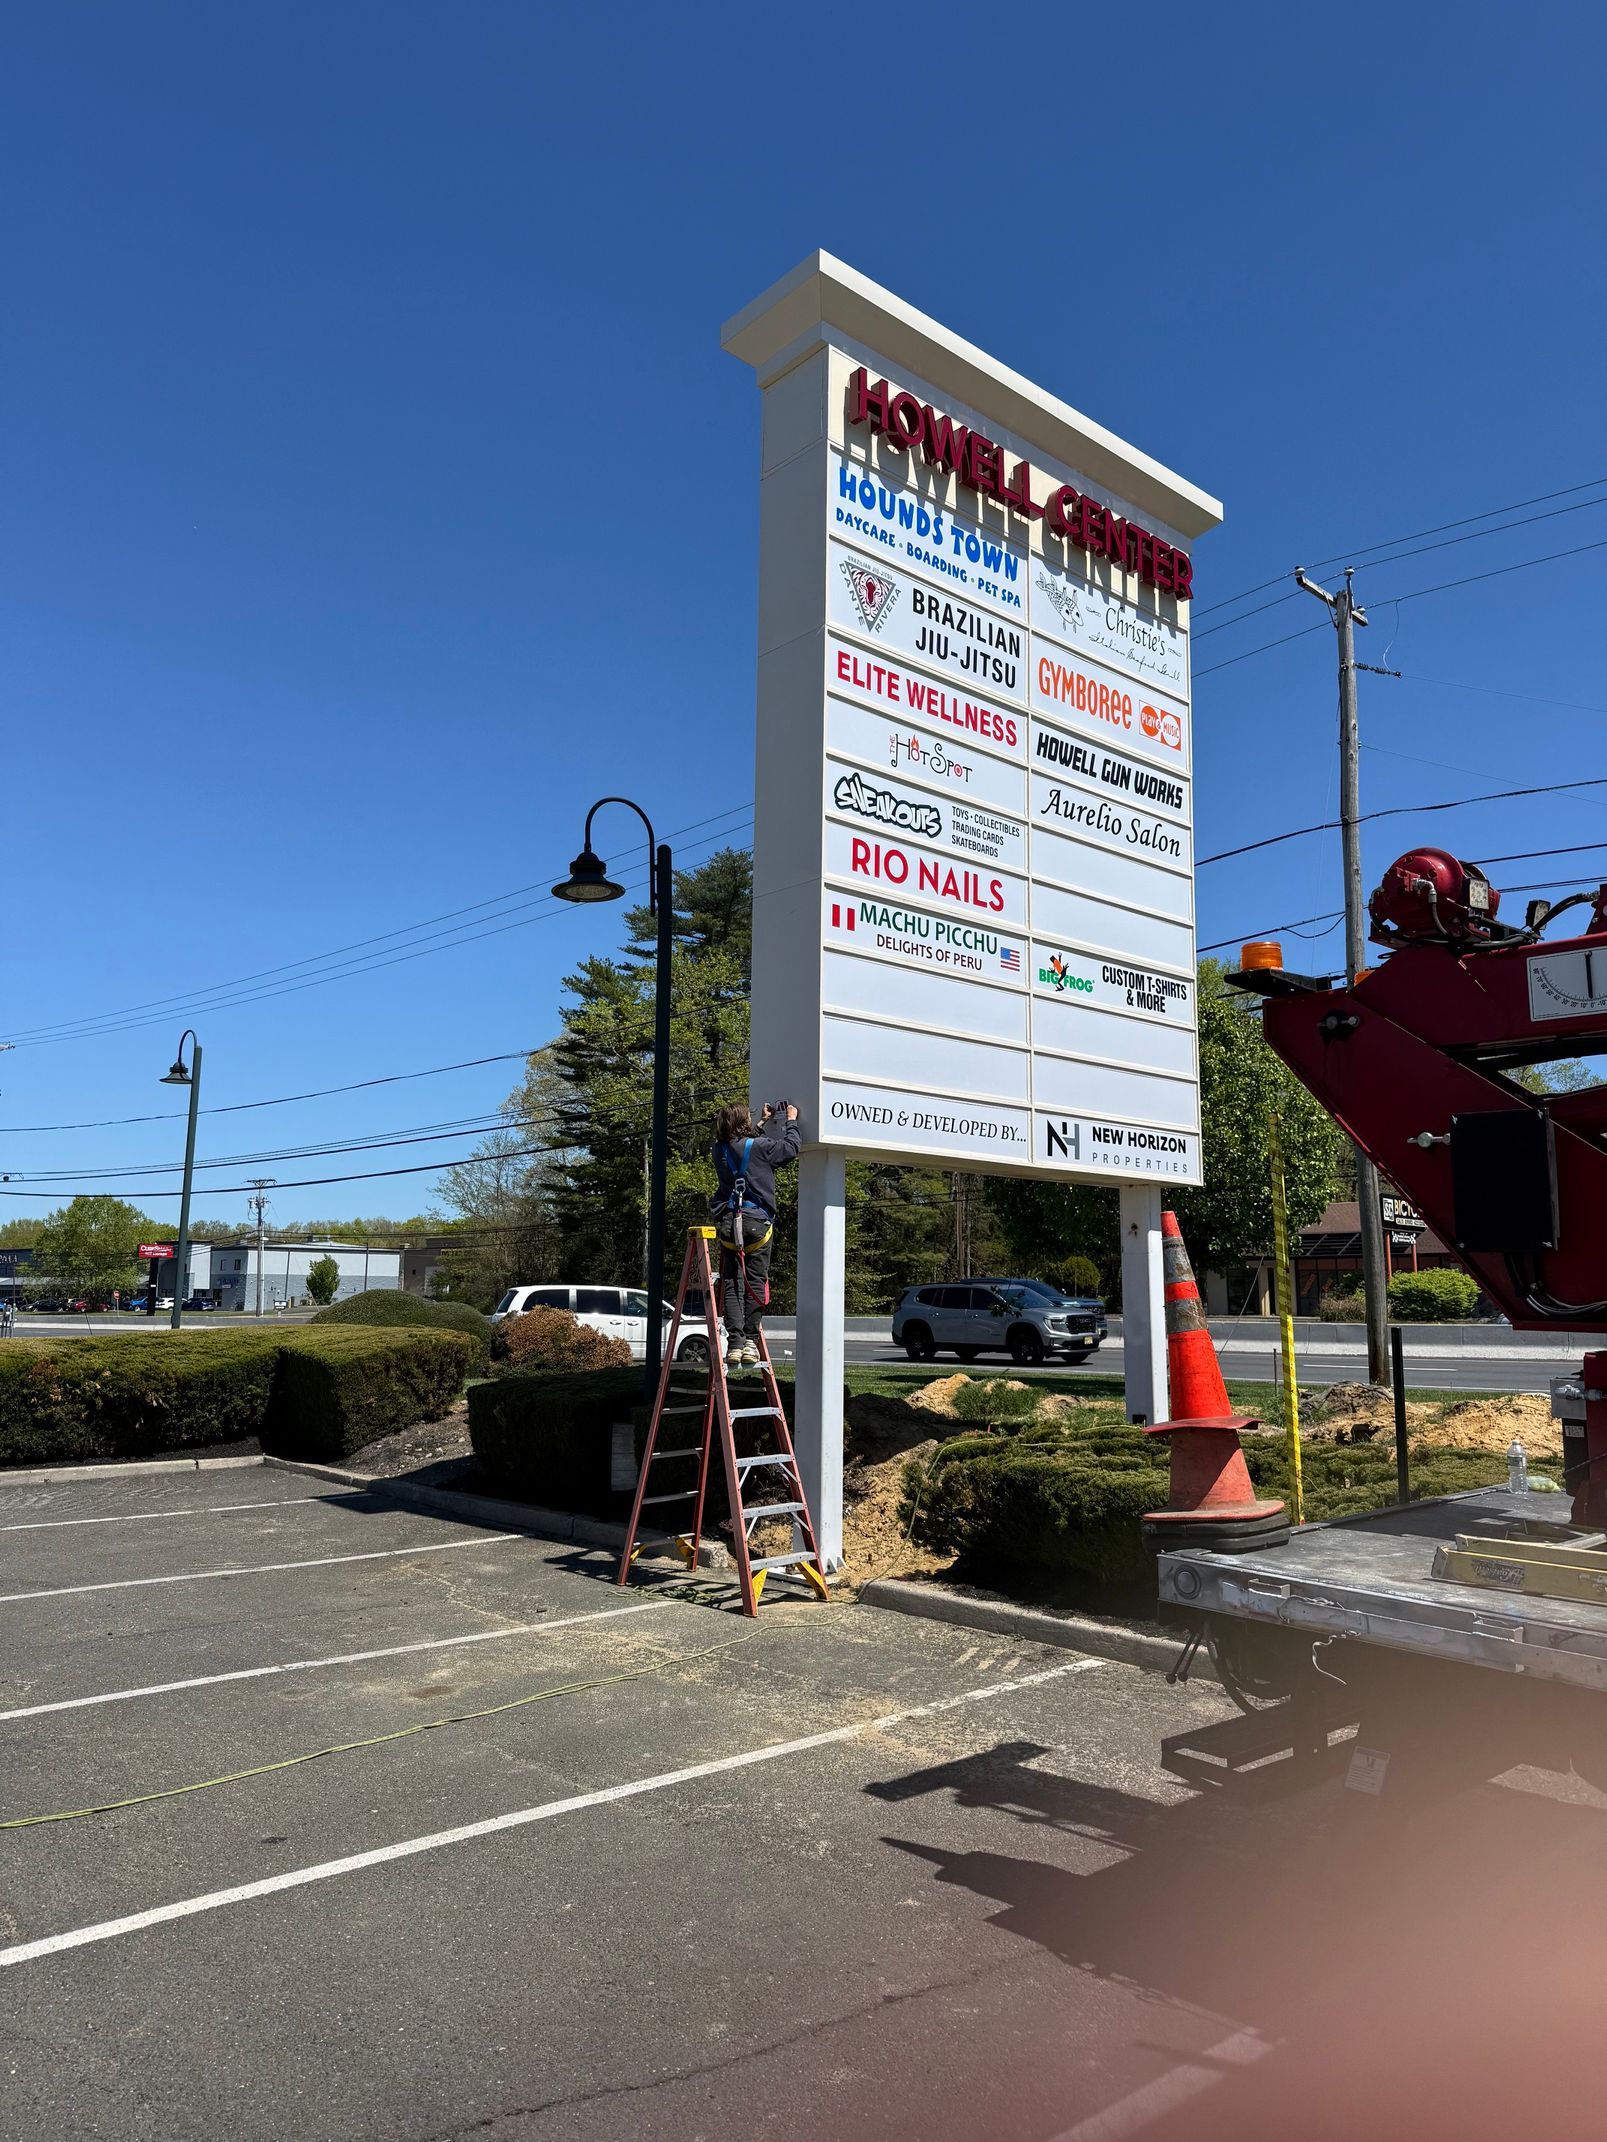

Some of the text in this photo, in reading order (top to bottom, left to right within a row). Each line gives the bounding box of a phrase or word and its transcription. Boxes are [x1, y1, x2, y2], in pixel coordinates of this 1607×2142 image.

[850, 367, 1193, 600] HOWELL CENTER
[840, 466, 1018, 582] HOUNDS TOWN
[836, 507, 1021, 608] DAYCARE BOARDING PET SPA
[848, 555, 872, 570] BRAZILIAN
[839, 563, 865, 626] DANTE
[874, 588, 902, 633] RIVERA
[912, 588, 1020, 658] BRAZILIAN
[1105, 606, 1166, 656] Christie's
[915, 626, 1016, 689] JIU-JITSU
[837, 650, 1017, 747] ELITE WELLNESS
[1163, 722, 1179, 738] MUSIC
[1036, 732, 1183, 809] HOWELL GUN WORKS
[834, 772, 942, 838] SNEAKOUTS
[952, 806, 1020, 838] TOYS COLLECTIBLES
[1040, 789, 1180, 857] Aurelio Salon
[952, 820, 1004, 846] TRADING CARDS
[952, 834, 998, 858] SKATEBOARDS
[852, 837, 1005, 912] RIO NAILS
[860, 902, 998, 955] MACHU PICCHU
[877, 933, 982, 971] DELIGHTS OF PERU
[1038, 967, 1094, 993] BIG FROG
[1102, 965, 1187, 1000] CUSTOM T-SHIRTS
[1126, 989, 1166, 1013] & MORE
[831, 1101, 1027, 1143] OWNED & DEVELOPED BY...
[1092, 1126, 1186, 1154] NEW HORIZON
[1092, 1152, 1188, 1173] PROPERTIES
